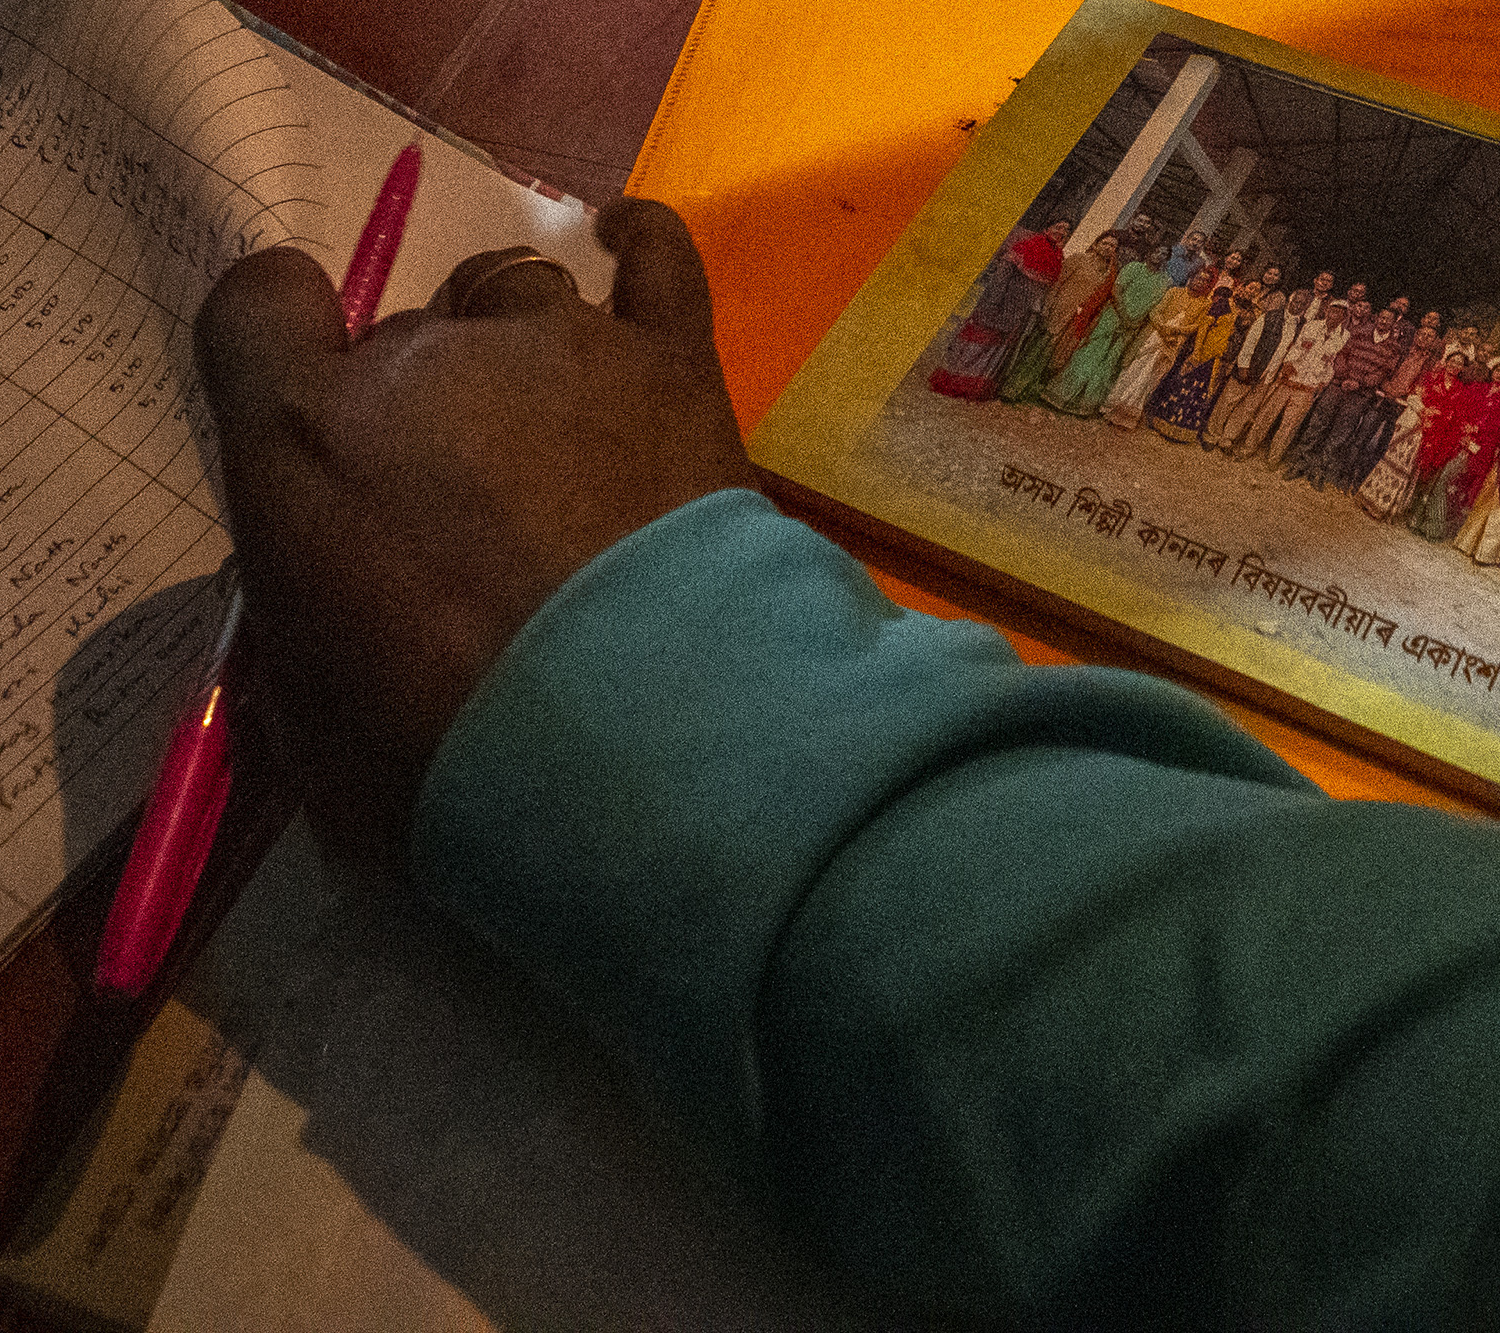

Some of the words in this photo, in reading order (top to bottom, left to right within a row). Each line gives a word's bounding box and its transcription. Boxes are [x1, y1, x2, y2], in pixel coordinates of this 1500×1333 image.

[998, 463, 1062, 510] অসম
[1068, 485, 1133, 540] শিল্পী
[1134, 517, 1227, 579] কাননৰ
[1401, 626, 1500, 692] একাংশ
